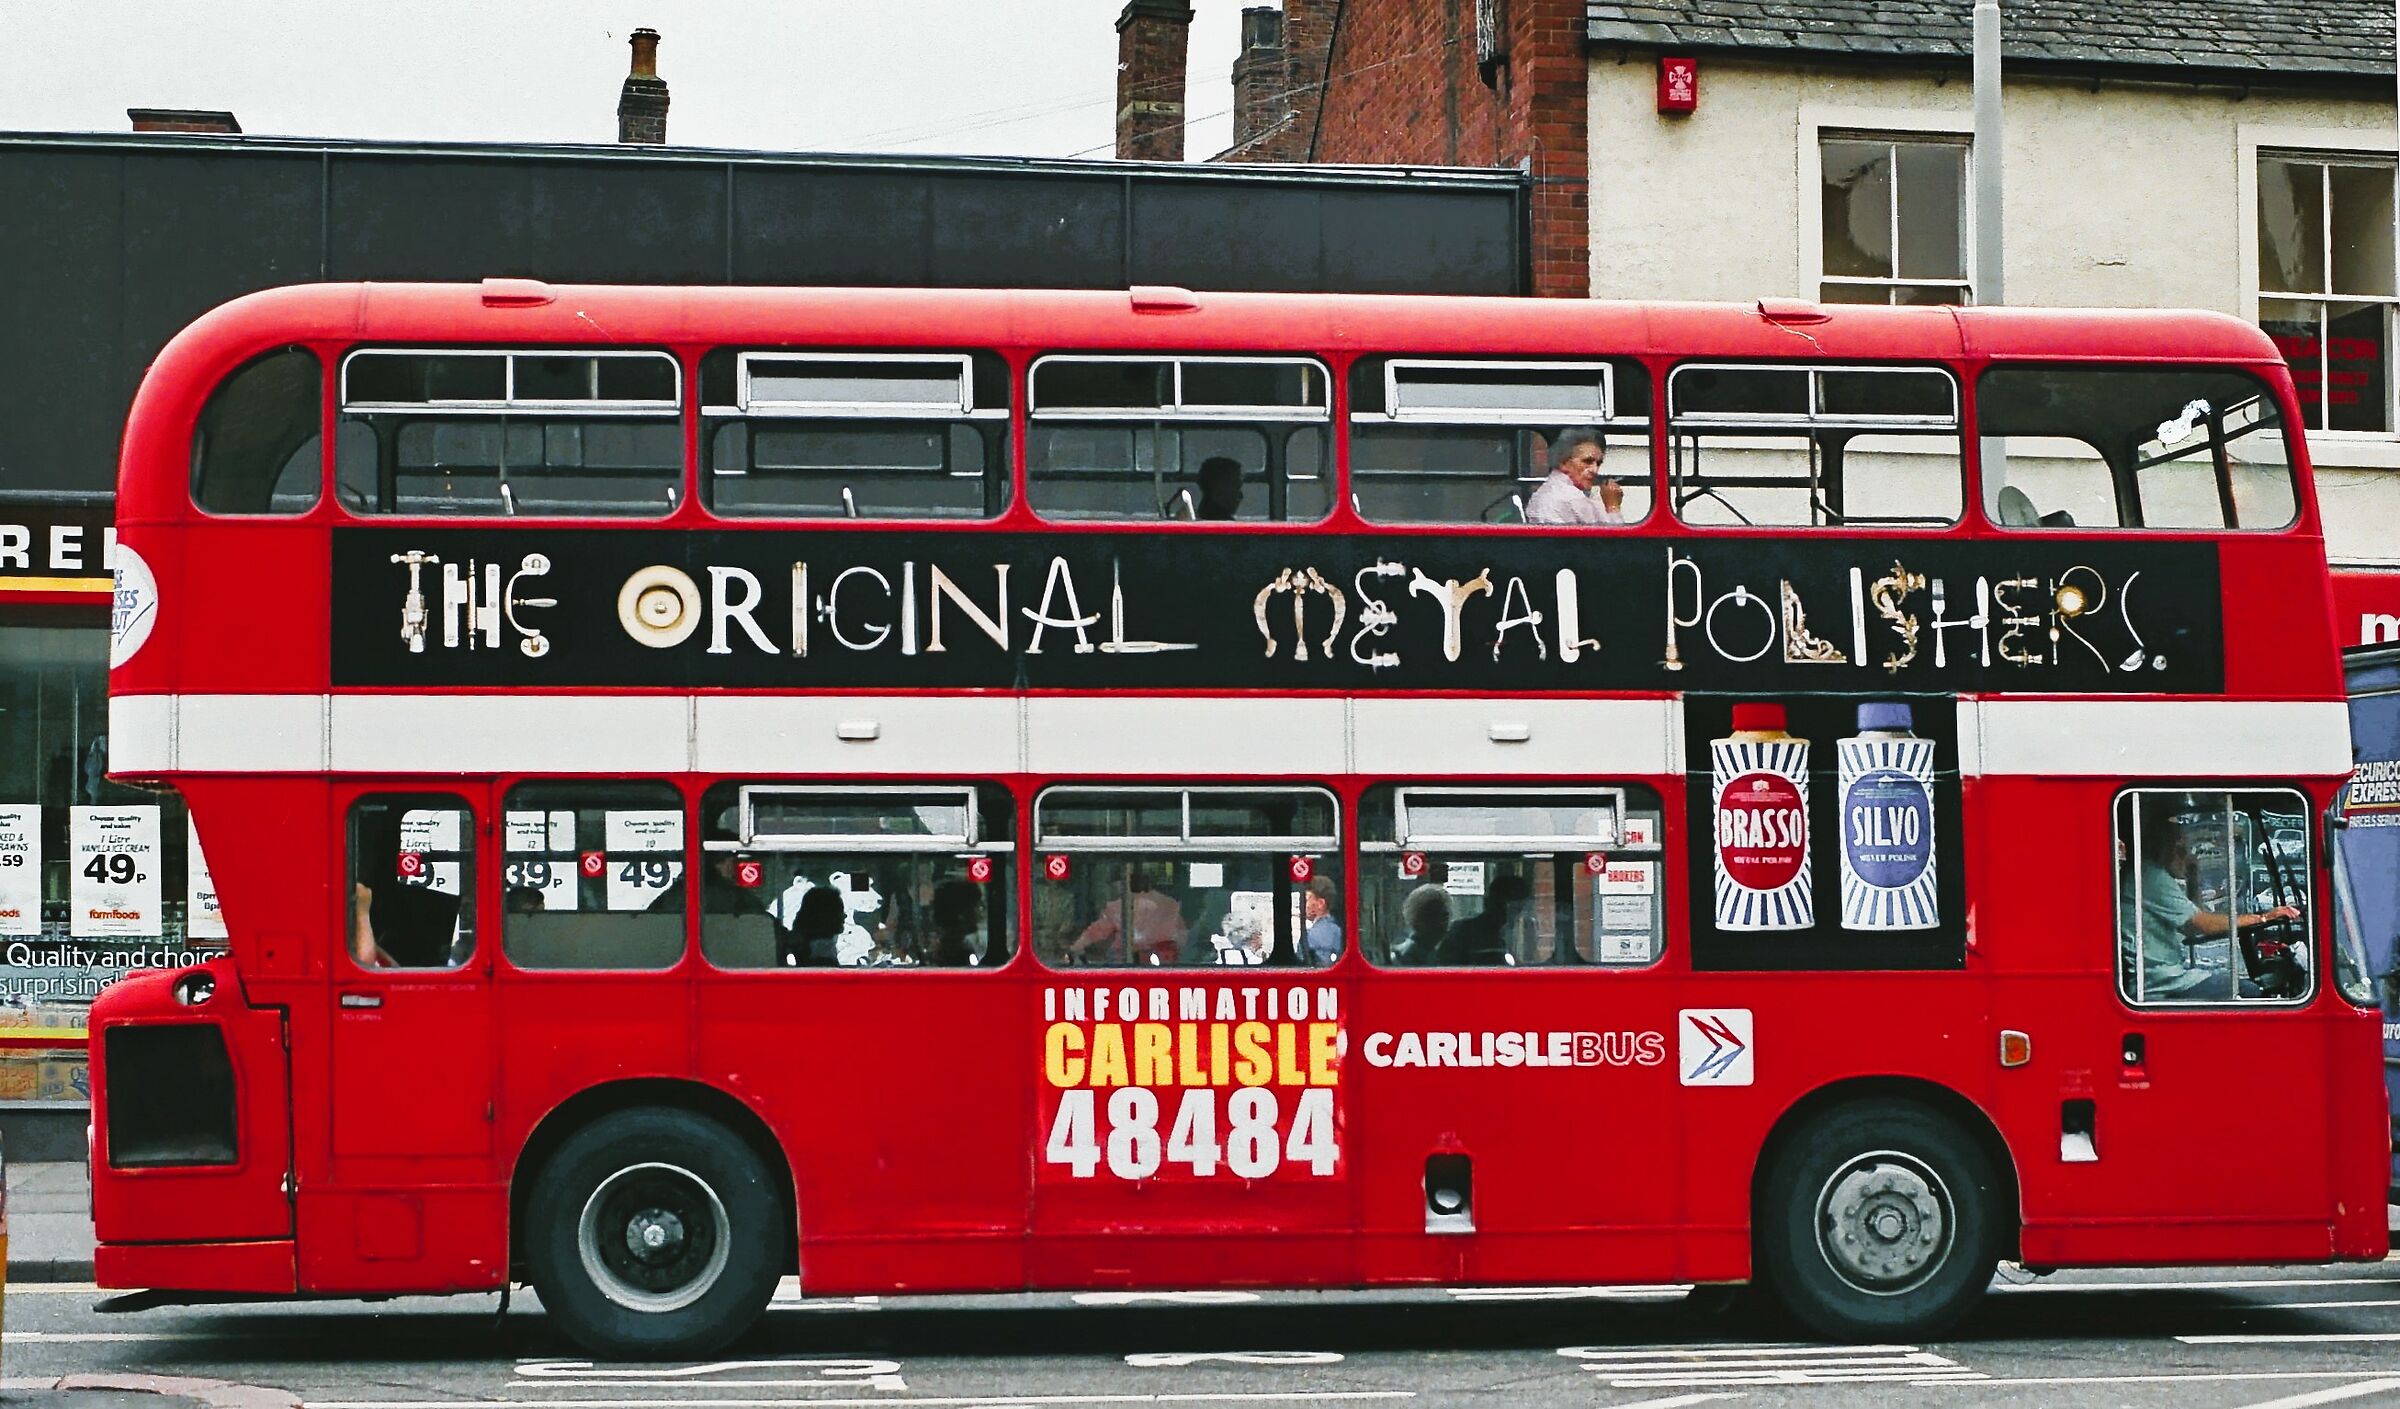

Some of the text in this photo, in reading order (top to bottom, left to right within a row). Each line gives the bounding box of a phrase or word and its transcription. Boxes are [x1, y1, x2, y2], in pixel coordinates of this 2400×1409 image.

[390, 550, 558, 658] THE
[617, 556, 1199, 658] ORIGINAL
[1253, 557, 1600, 672] METAL
[2352, 761, 2400, 782] ECURICO
[2351, 781, 2400, 803] EXPRES
[1720, 808, 1803, 849] BRASSO
[1852, 805, 1920, 847] SILVO
[0, 842, 29, 851] RAWNS
[0, 854, 24, 868] .59
[7, 942, 97, 974] Quality
[101, 945, 146, 968] and
[1044, 987, 1338, 1021] INFORMATION
[1045, 1021, 1339, 1087] CARLISLE
[1046, 1087, 1341, 1180] 48484
